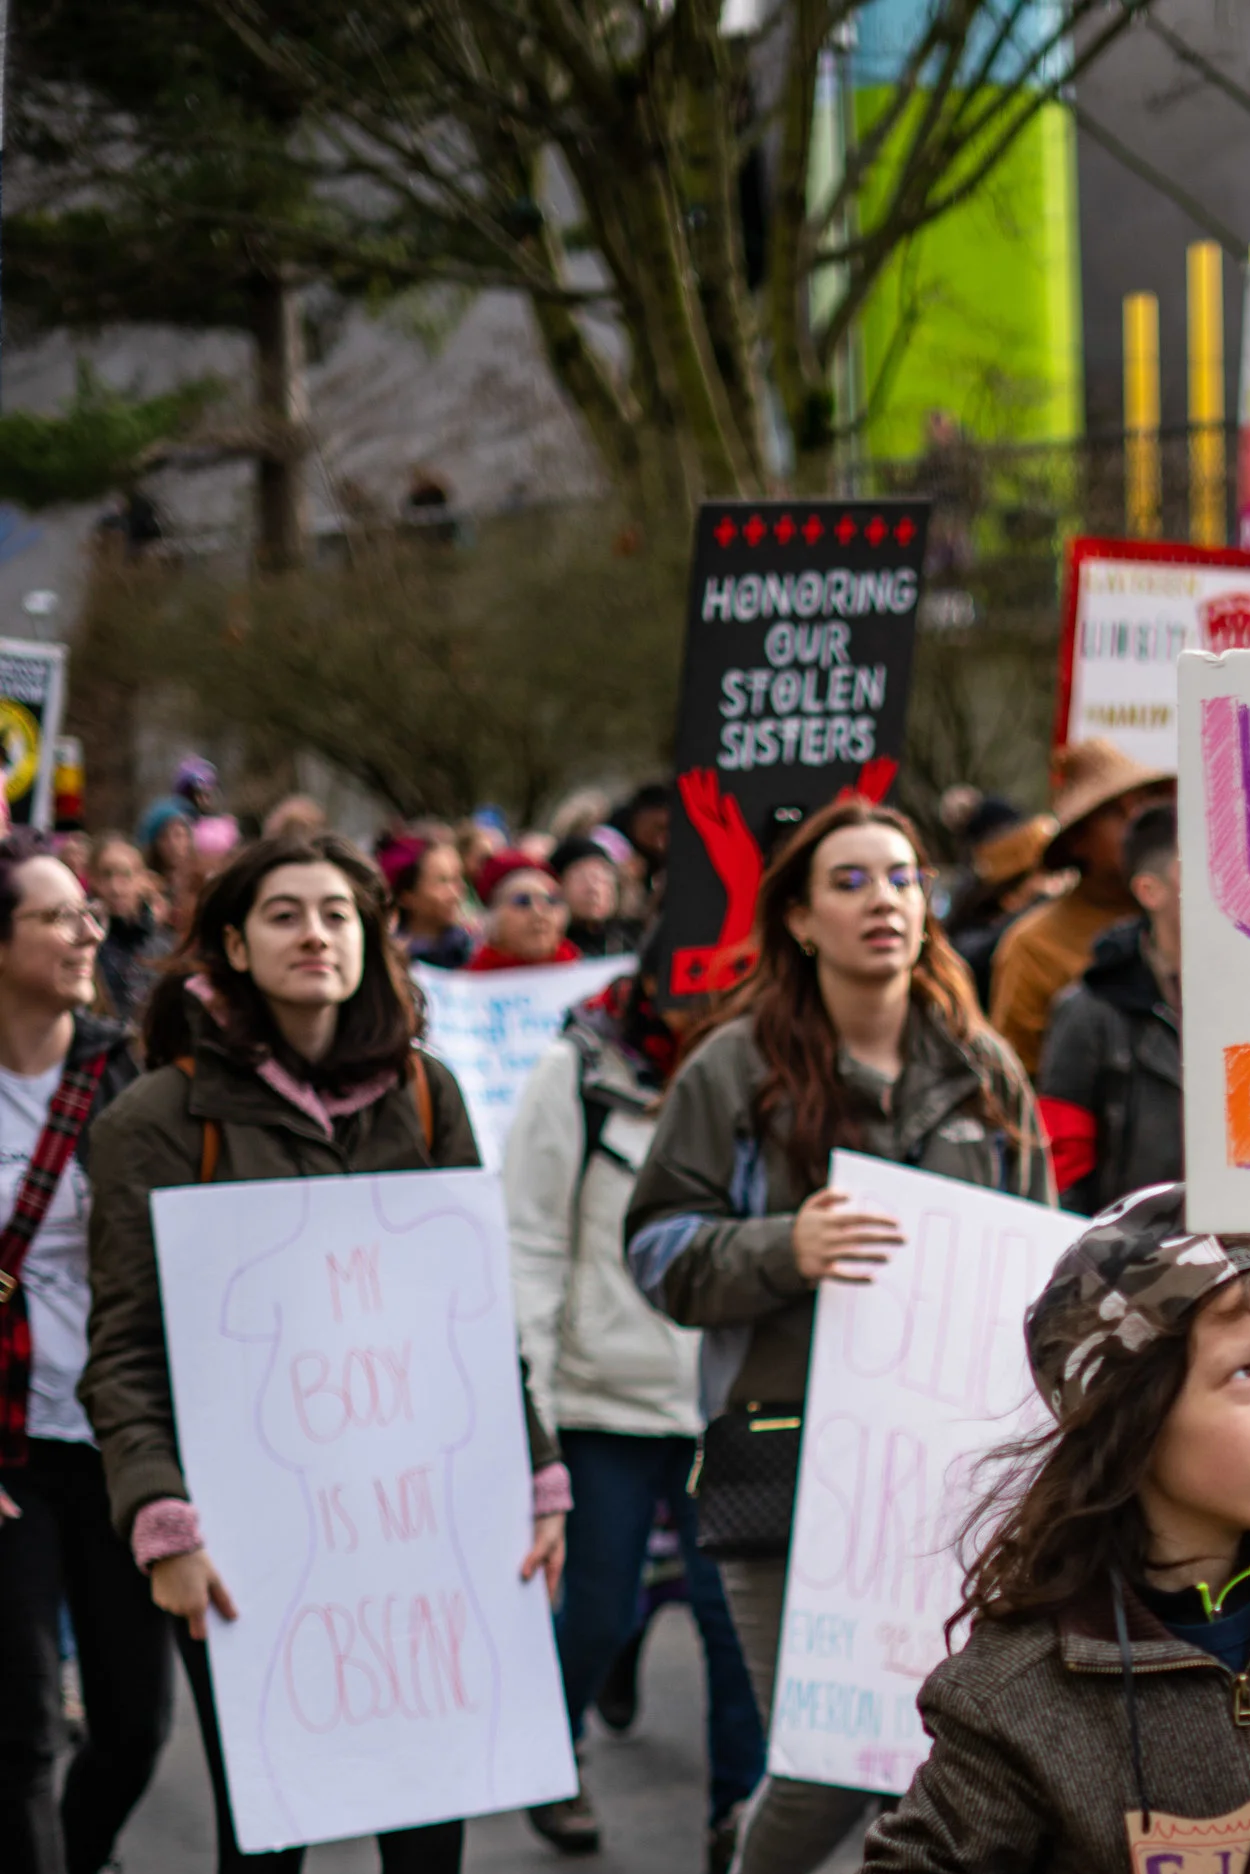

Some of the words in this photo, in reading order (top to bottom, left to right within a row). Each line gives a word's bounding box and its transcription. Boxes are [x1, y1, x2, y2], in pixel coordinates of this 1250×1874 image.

[702, 567, 918, 622] HONORING
[764, 619, 851, 669] OUR
[719, 663, 887, 718] STOLEN
[716, 715, 876, 771] SISTERS
[325, 1243, 383, 1323] MY
[289, 1338, 416, 1445] BODY
[317, 1483, 359, 1553] IS
[372, 1464, 438, 1545] NOT
